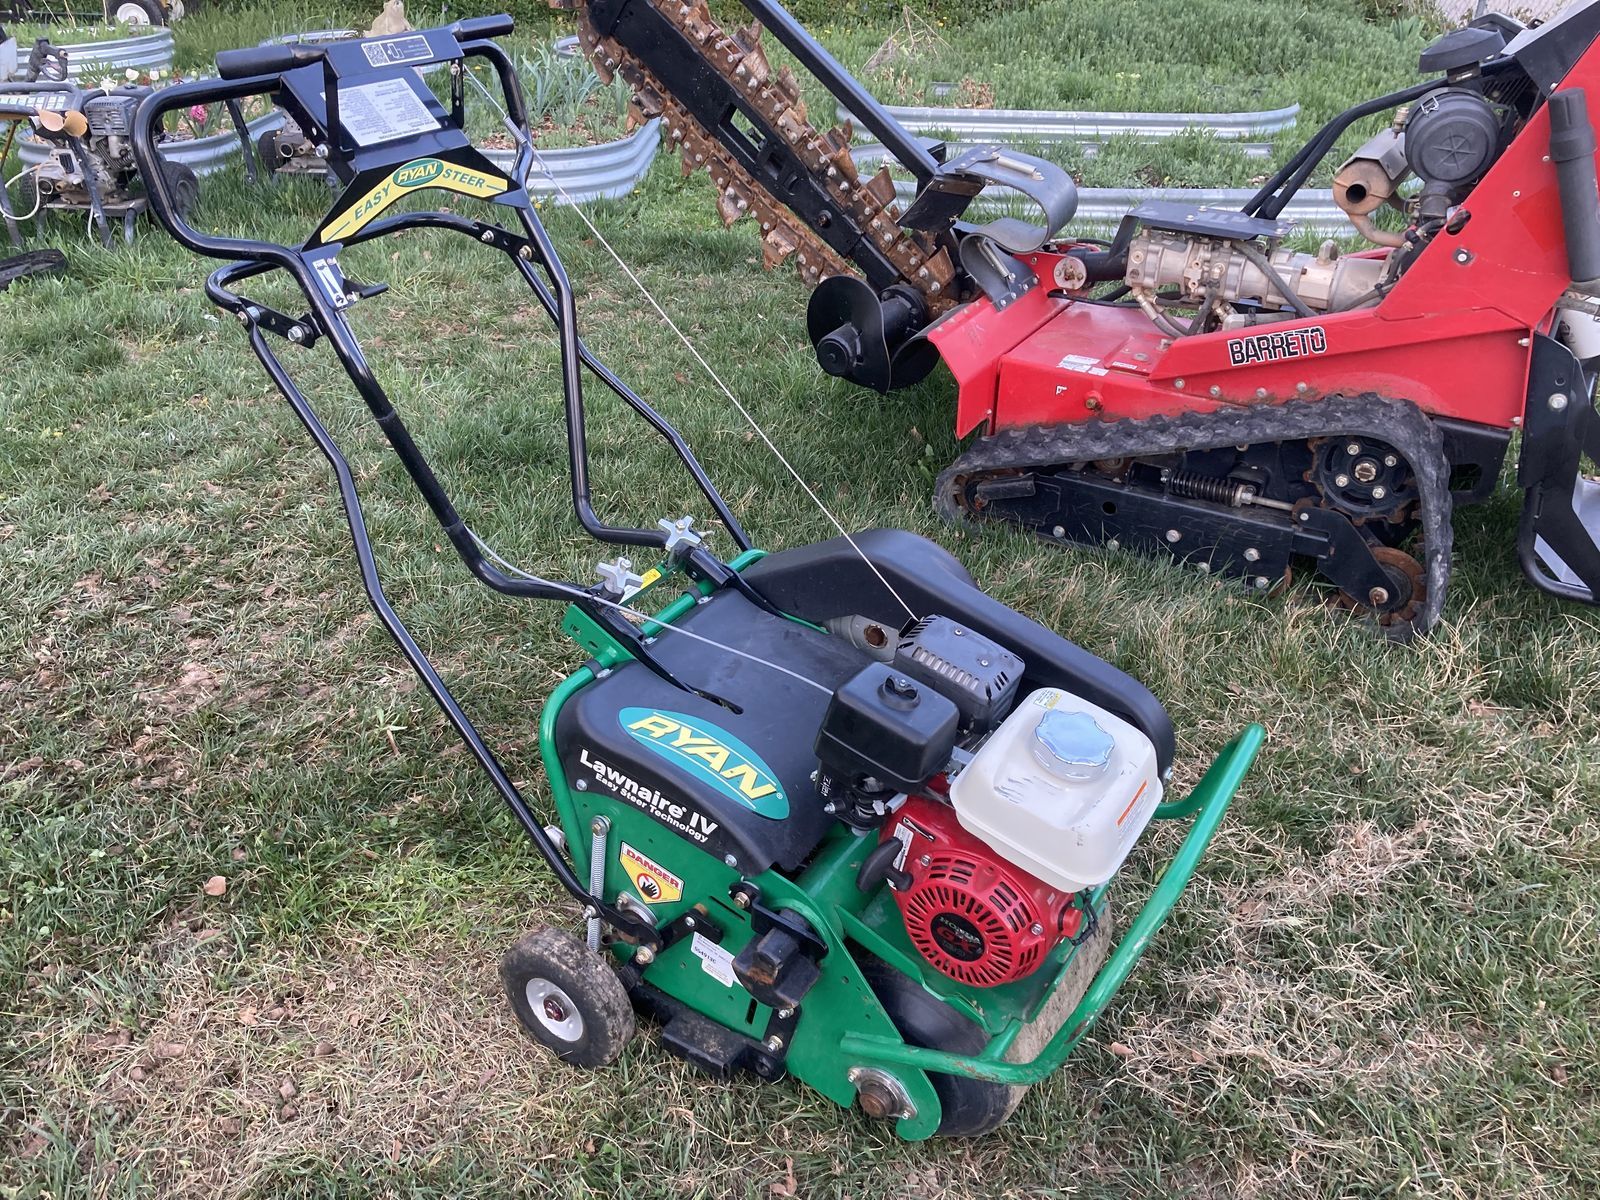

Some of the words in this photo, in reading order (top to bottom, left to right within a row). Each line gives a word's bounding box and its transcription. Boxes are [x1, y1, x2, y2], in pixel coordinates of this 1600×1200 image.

[354, 183, 392, 220] EASY
[397, 162, 438, 184] RYAN
[442, 168, 486, 189] STEER
[1228, 326, 1327, 366] BARRETO
[627, 715, 777, 799] RYAN
[580, 749, 684, 819] Lawnaire
[689, 812, 719, 836] IV
[595, 773, 619, 792] Easy
[620, 789, 648, 809] Steer
[649, 805, 709, 843] Technology
[626, 848, 680, 888] DANGER
